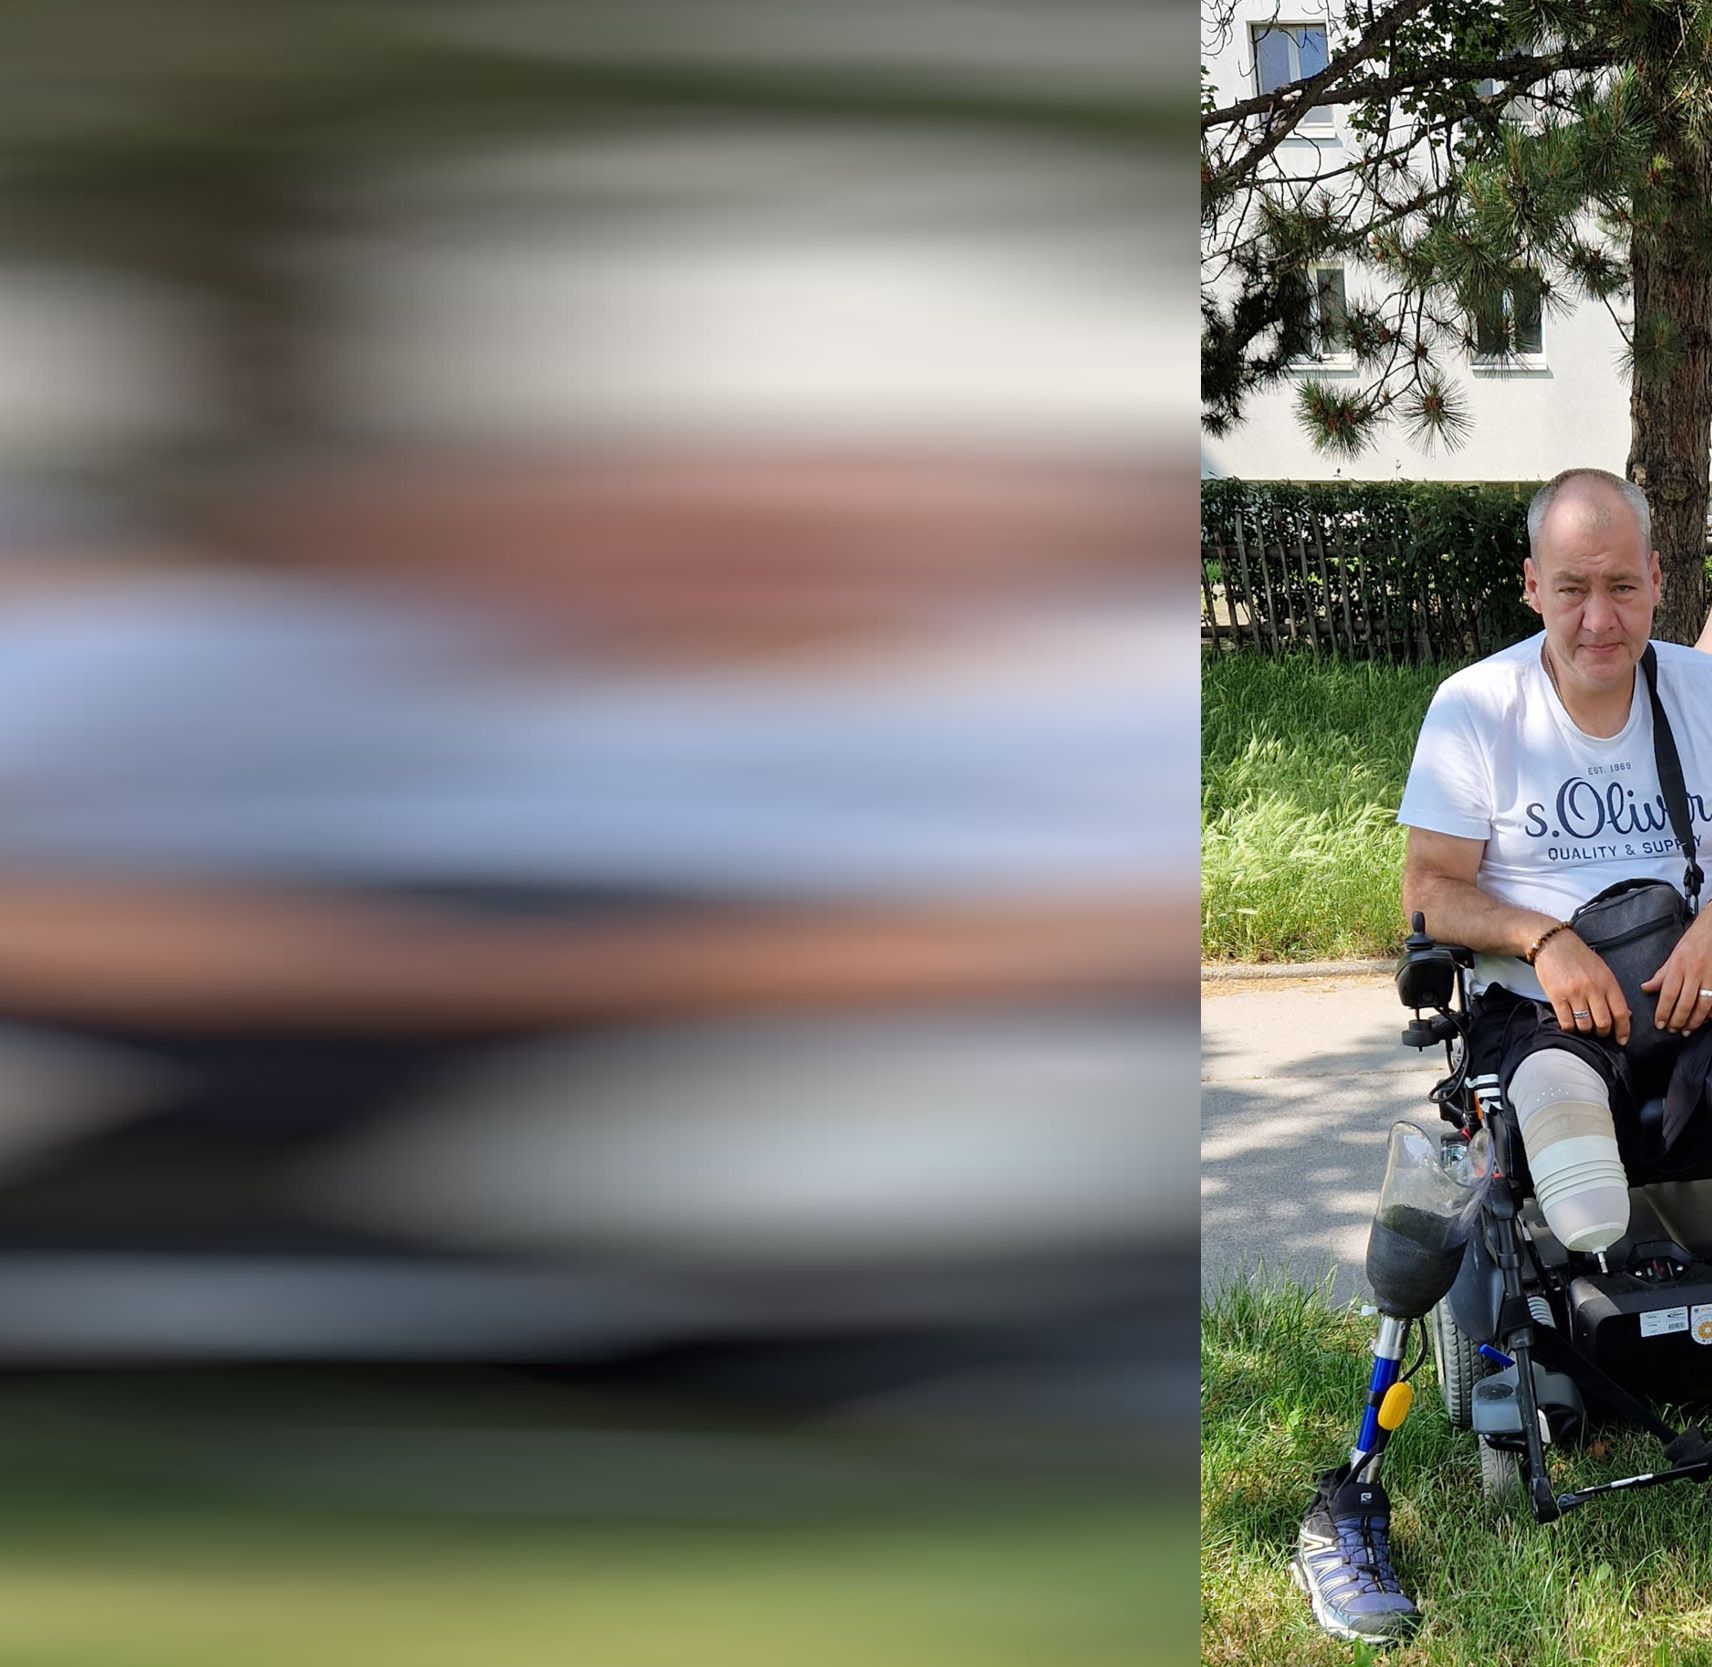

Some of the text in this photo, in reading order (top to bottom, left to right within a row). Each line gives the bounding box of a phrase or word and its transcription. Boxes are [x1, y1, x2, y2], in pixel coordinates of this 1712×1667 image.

[1609, 762, 1632, 773] 1969
[1525, 776, 1712, 839] s.Olivr
[1549, 834, 1702, 861] QUALITY & SUPPY
